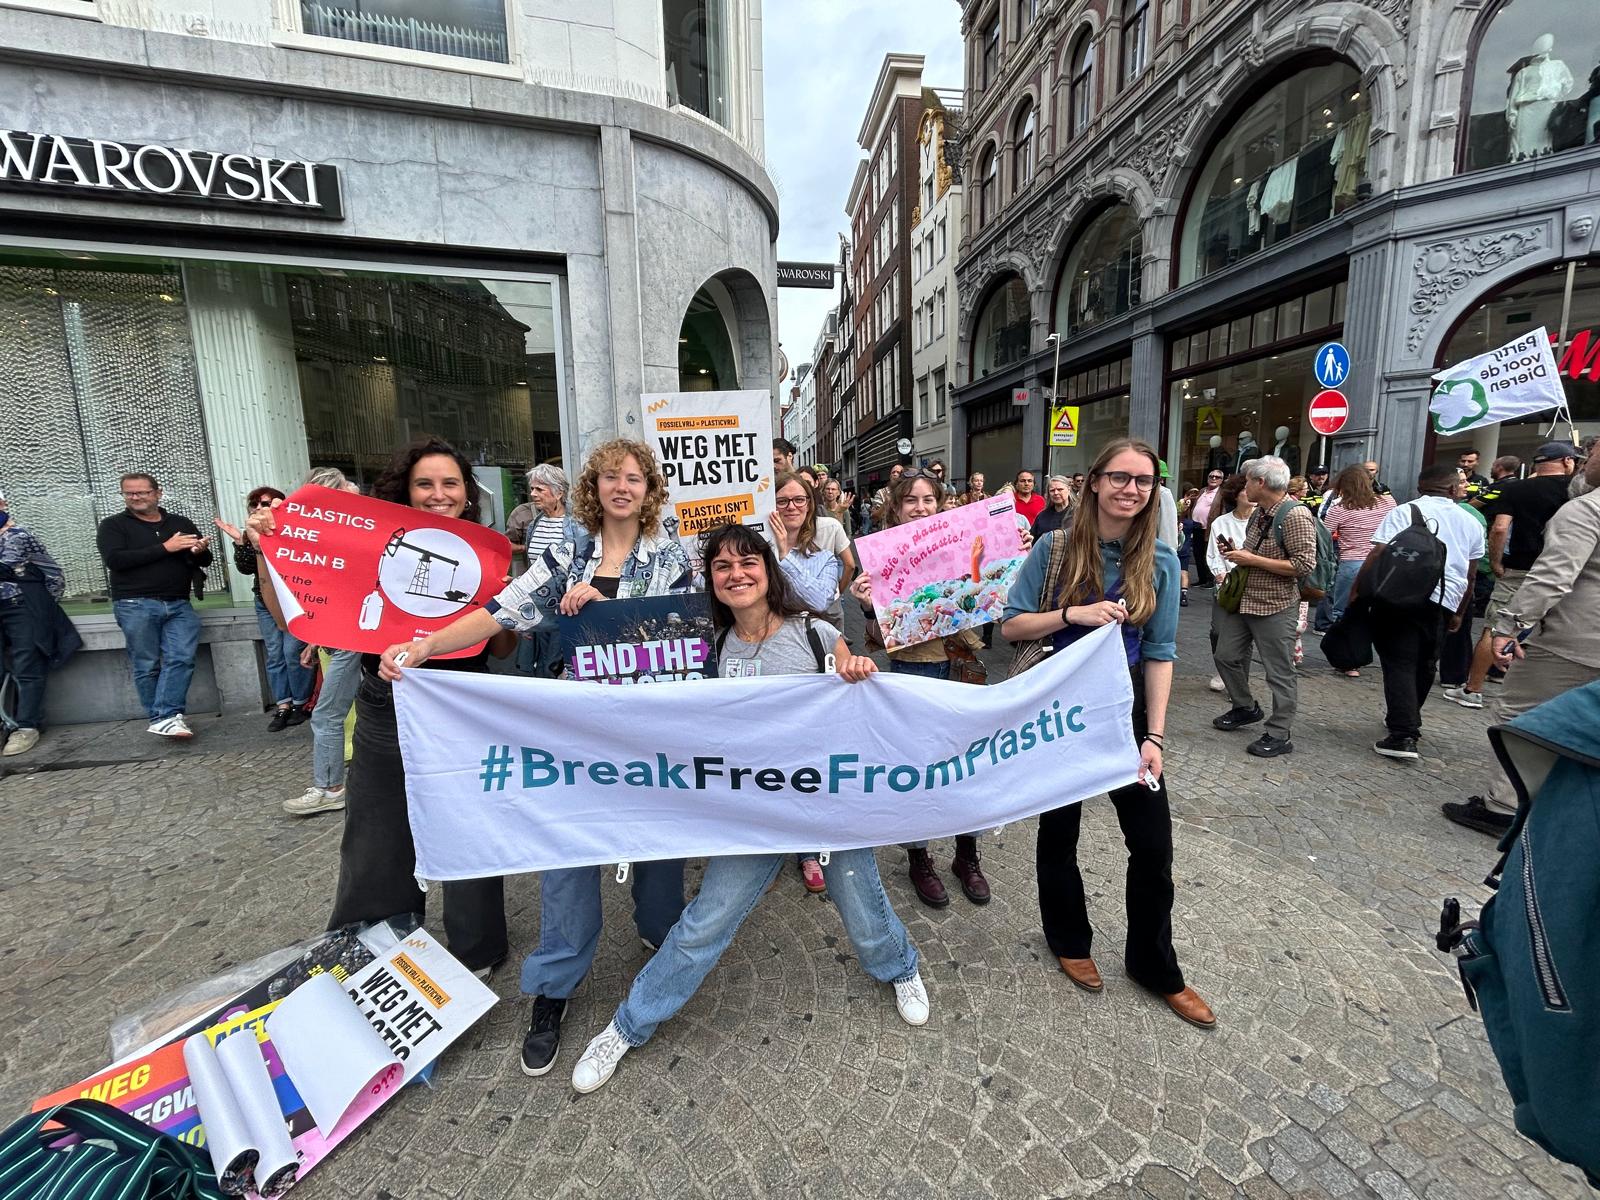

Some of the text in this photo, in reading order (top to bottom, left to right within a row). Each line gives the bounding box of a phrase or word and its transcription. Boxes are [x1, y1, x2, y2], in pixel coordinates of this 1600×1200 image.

[777, 268, 831, 281] SWAROVSKI
[626, 409, 635, 425] 6
[659, 420, 696, 429] FOSSIELVRIJ
[700, 418, 737, 428] PLASTICVRIJ
[658, 432, 758, 461] WEG MET
[662, 458, 759, 487] PLASTIC
[286, 501, 377, 531] PLASTICS
[681, 500, 749, 520] PLASTIC ISN'T
[280, 524, 320, 543] ARE
[899, 541, 911, 556] in
[911, 519, 950, 544] plastic
[275, 546, 346, 570] PLAN B
[909, 530, 965, 569] fantastic!
[292, 575, 313, 586] the
[303, 592, 329, 606] fuel
[575, 637, 704, 678] END THE
[479, 699, 1086, 793] #BreakFreeFromPlastic
[394, 956, 419, 982] FOSSIELVRIJ
[418, 980, 447, 1006] PLASTICVRIJ
[359, 966, 443, 1047] WEG MET
[80, 1064, 151, 1103] WEG
